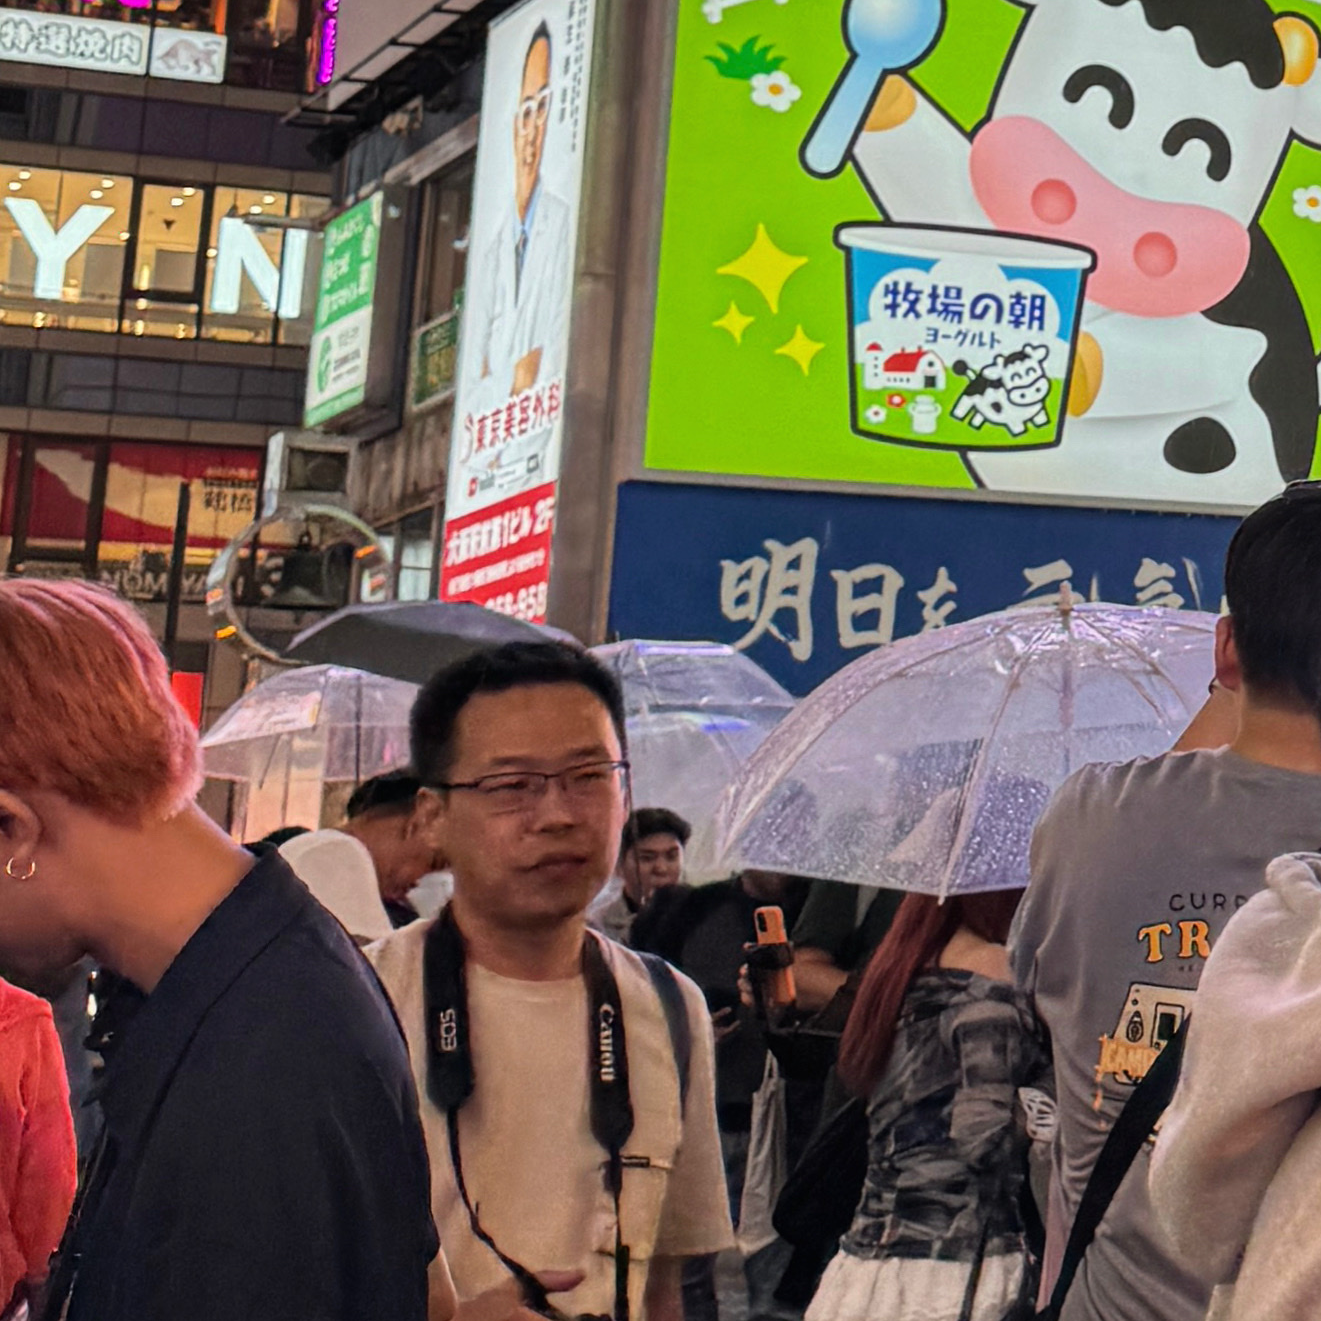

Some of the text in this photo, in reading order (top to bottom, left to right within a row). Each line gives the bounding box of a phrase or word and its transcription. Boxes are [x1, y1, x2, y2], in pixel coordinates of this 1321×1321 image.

[883, 282, 1047, 331] 牧場の朝
[925, 327, 1001, 351] ヨーグルト
[440, 1008, 458, 1052] EOS
[600, 1003, 625, 1082] Canon
